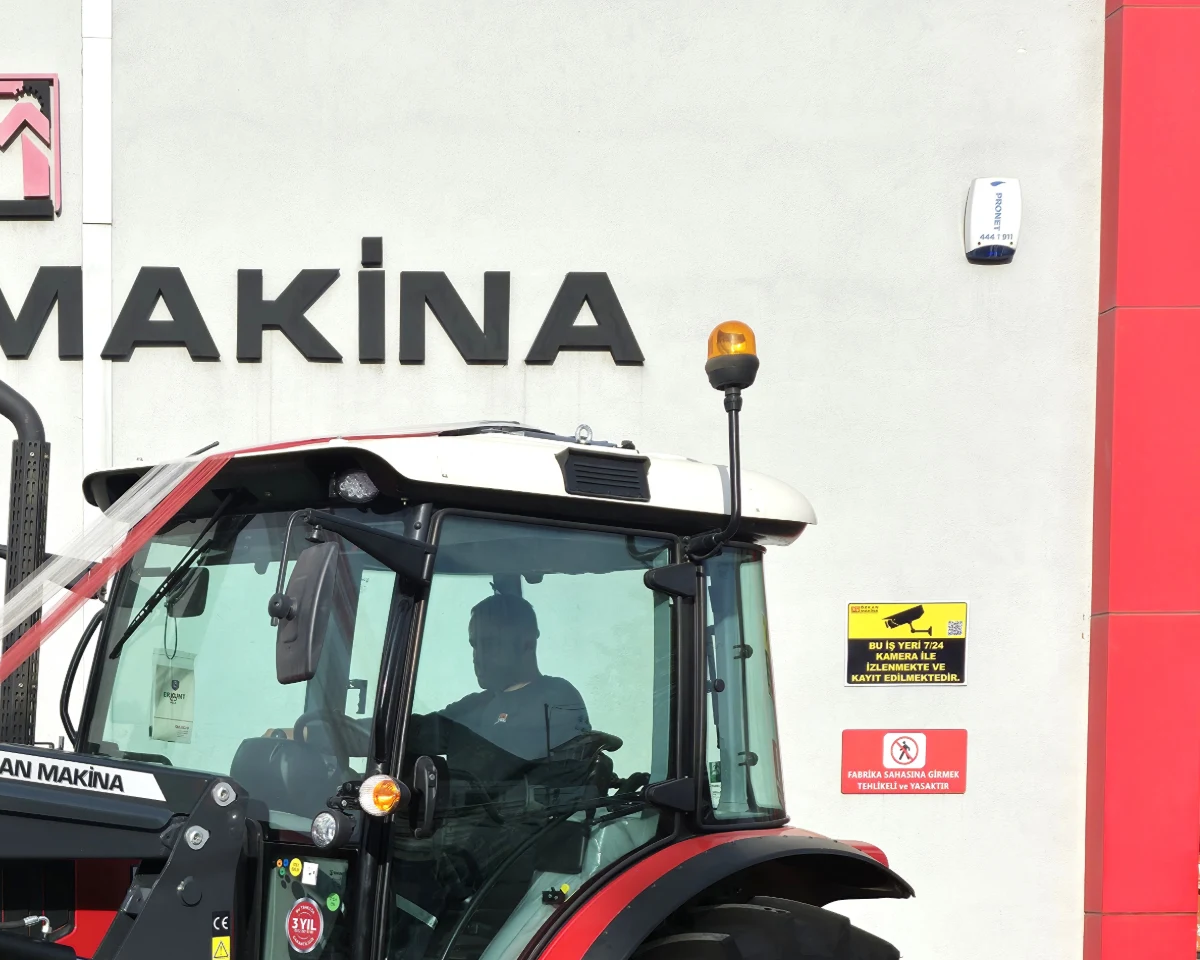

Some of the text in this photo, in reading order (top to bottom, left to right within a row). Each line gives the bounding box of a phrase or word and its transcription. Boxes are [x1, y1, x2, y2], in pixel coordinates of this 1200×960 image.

[994, 193, 1002, 231] PRONET
[979, 233, 995, 241] 444
[868, 640, 944, 651] BU İŞ YERİ 7/24
[875, 651, 936, 660] KAMERA İLE
[866, 662, 946, 671] İZLENMEKTE VE
[851, 672, 960, 682] KAYIT EDİLMEKTEDİR.
[37, 763, 125, 793] MAKİNA
[847, 769, 960, 779] FABRİKA SAHASINA GİRMEK
[857, 781, 897, 790] TEHLİKELİ
[910, 782, 949, 790] YASAKTIR
[291, 917, 317, 931] 3 YIL
